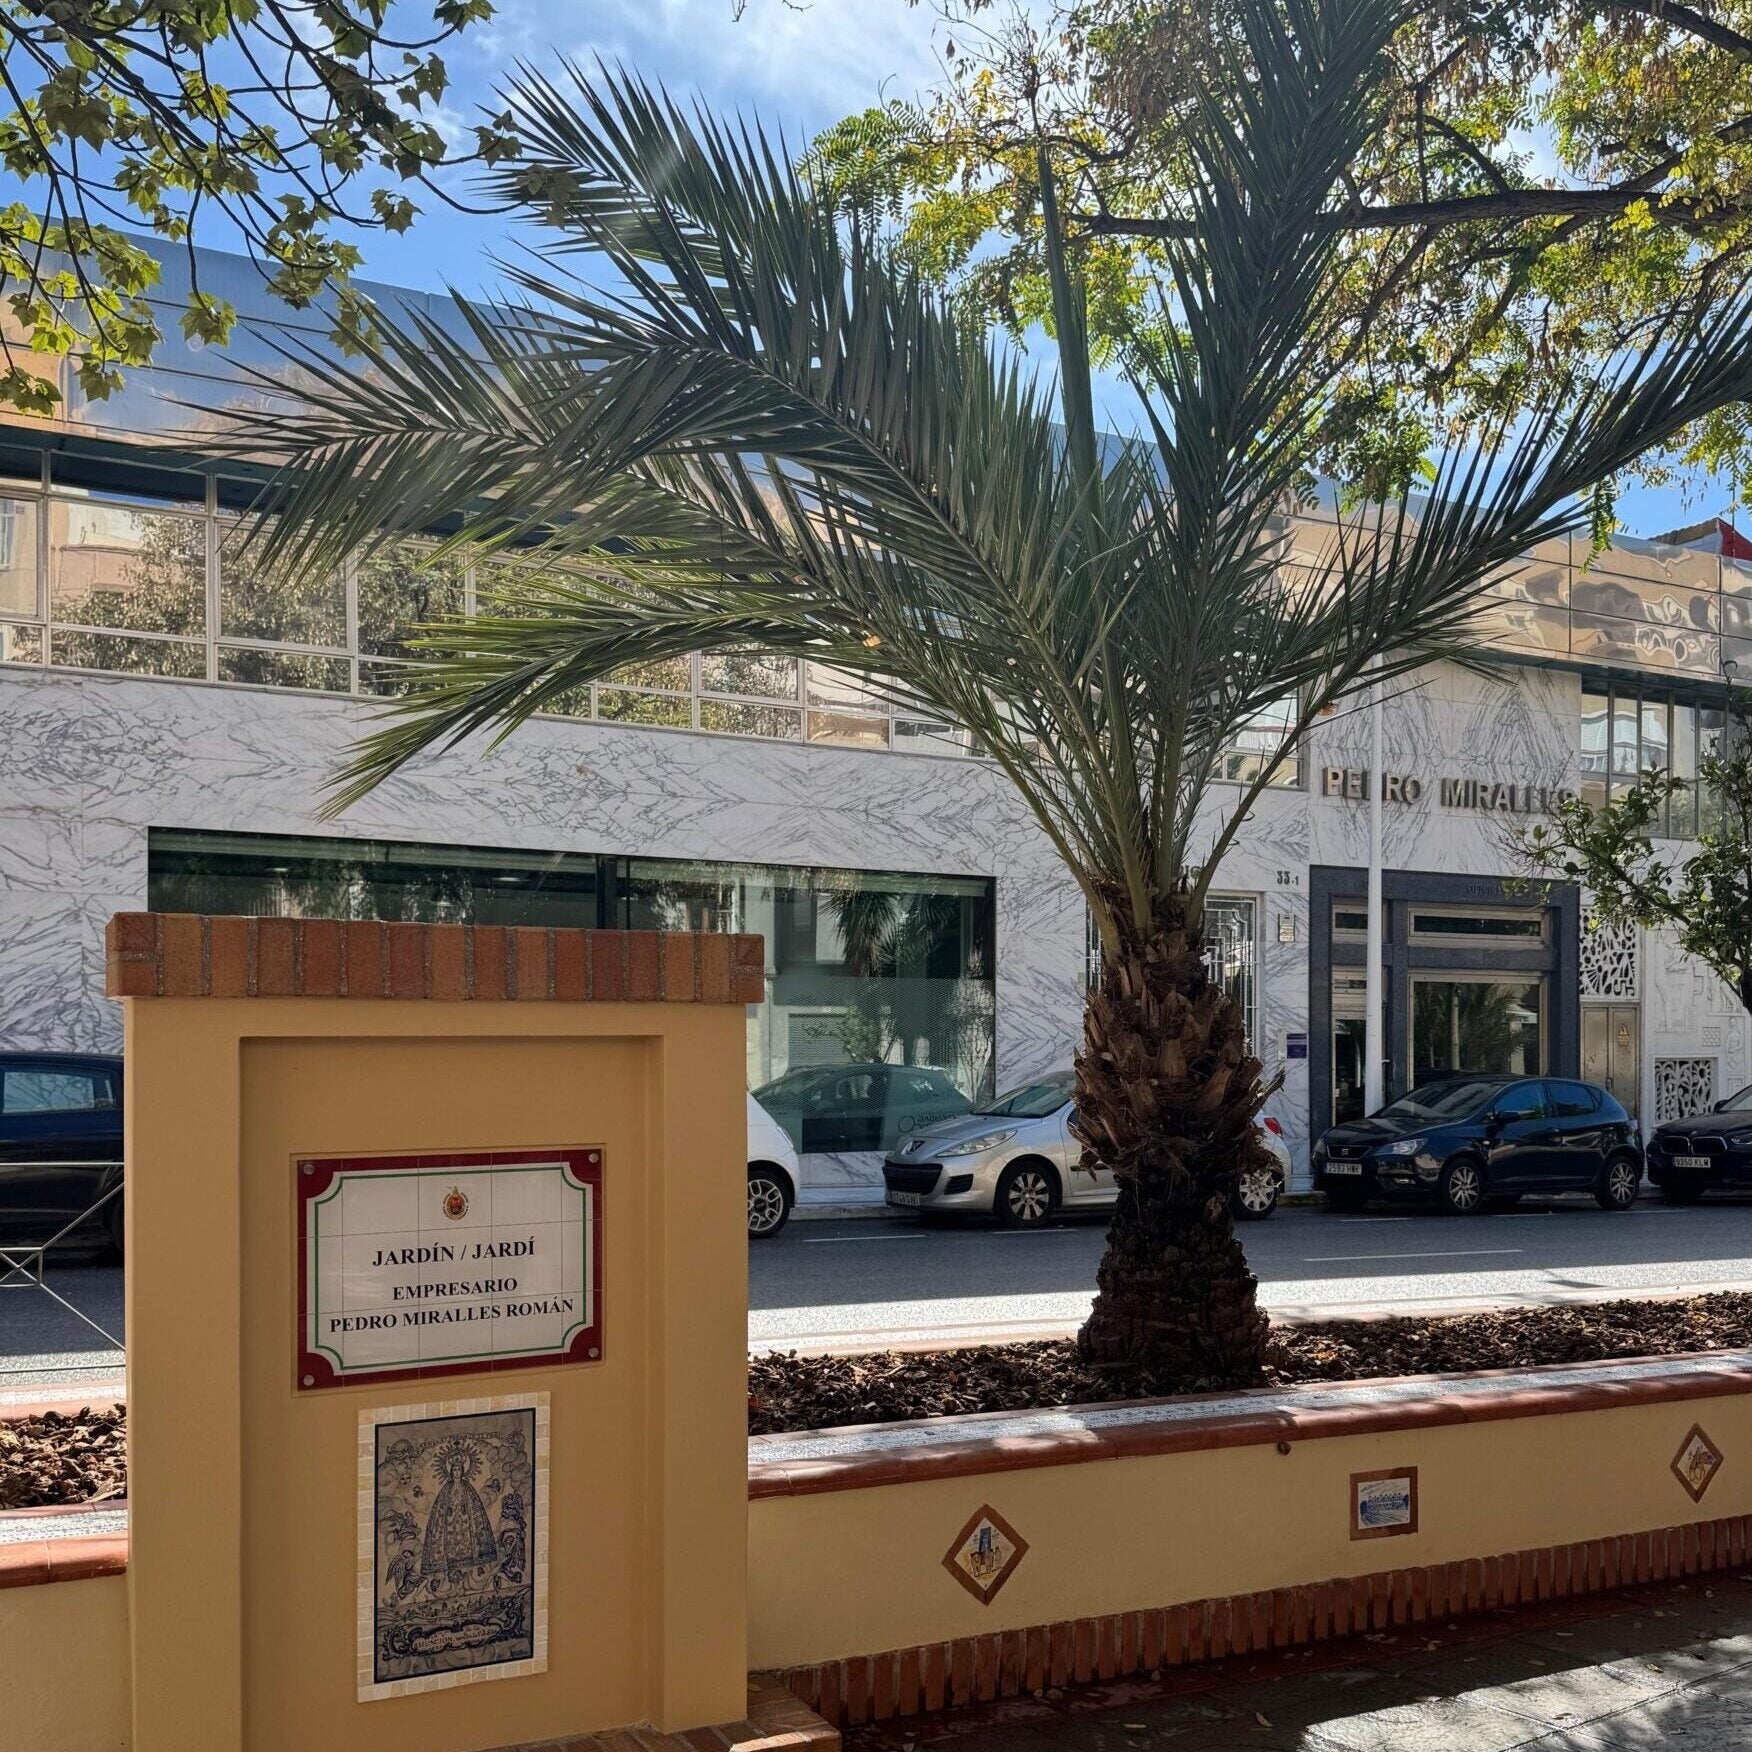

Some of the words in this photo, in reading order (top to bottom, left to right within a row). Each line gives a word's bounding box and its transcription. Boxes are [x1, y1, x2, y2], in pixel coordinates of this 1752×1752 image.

[1322, 767, 1423, 804] PERO
[372, 1242, 455, 1267] JARDÍN
[460, 1245, 467, 1260] /
[471, 1236, 535, 1260] JARDÍ
[392, 1277, 518, 1301] EMPRESARIO
[329, 1314, 397, 1333] PEDRO
[402, 1304, 501, 1327] MIRALLES
[505, 1296, 574, 1318] ROMÁN
